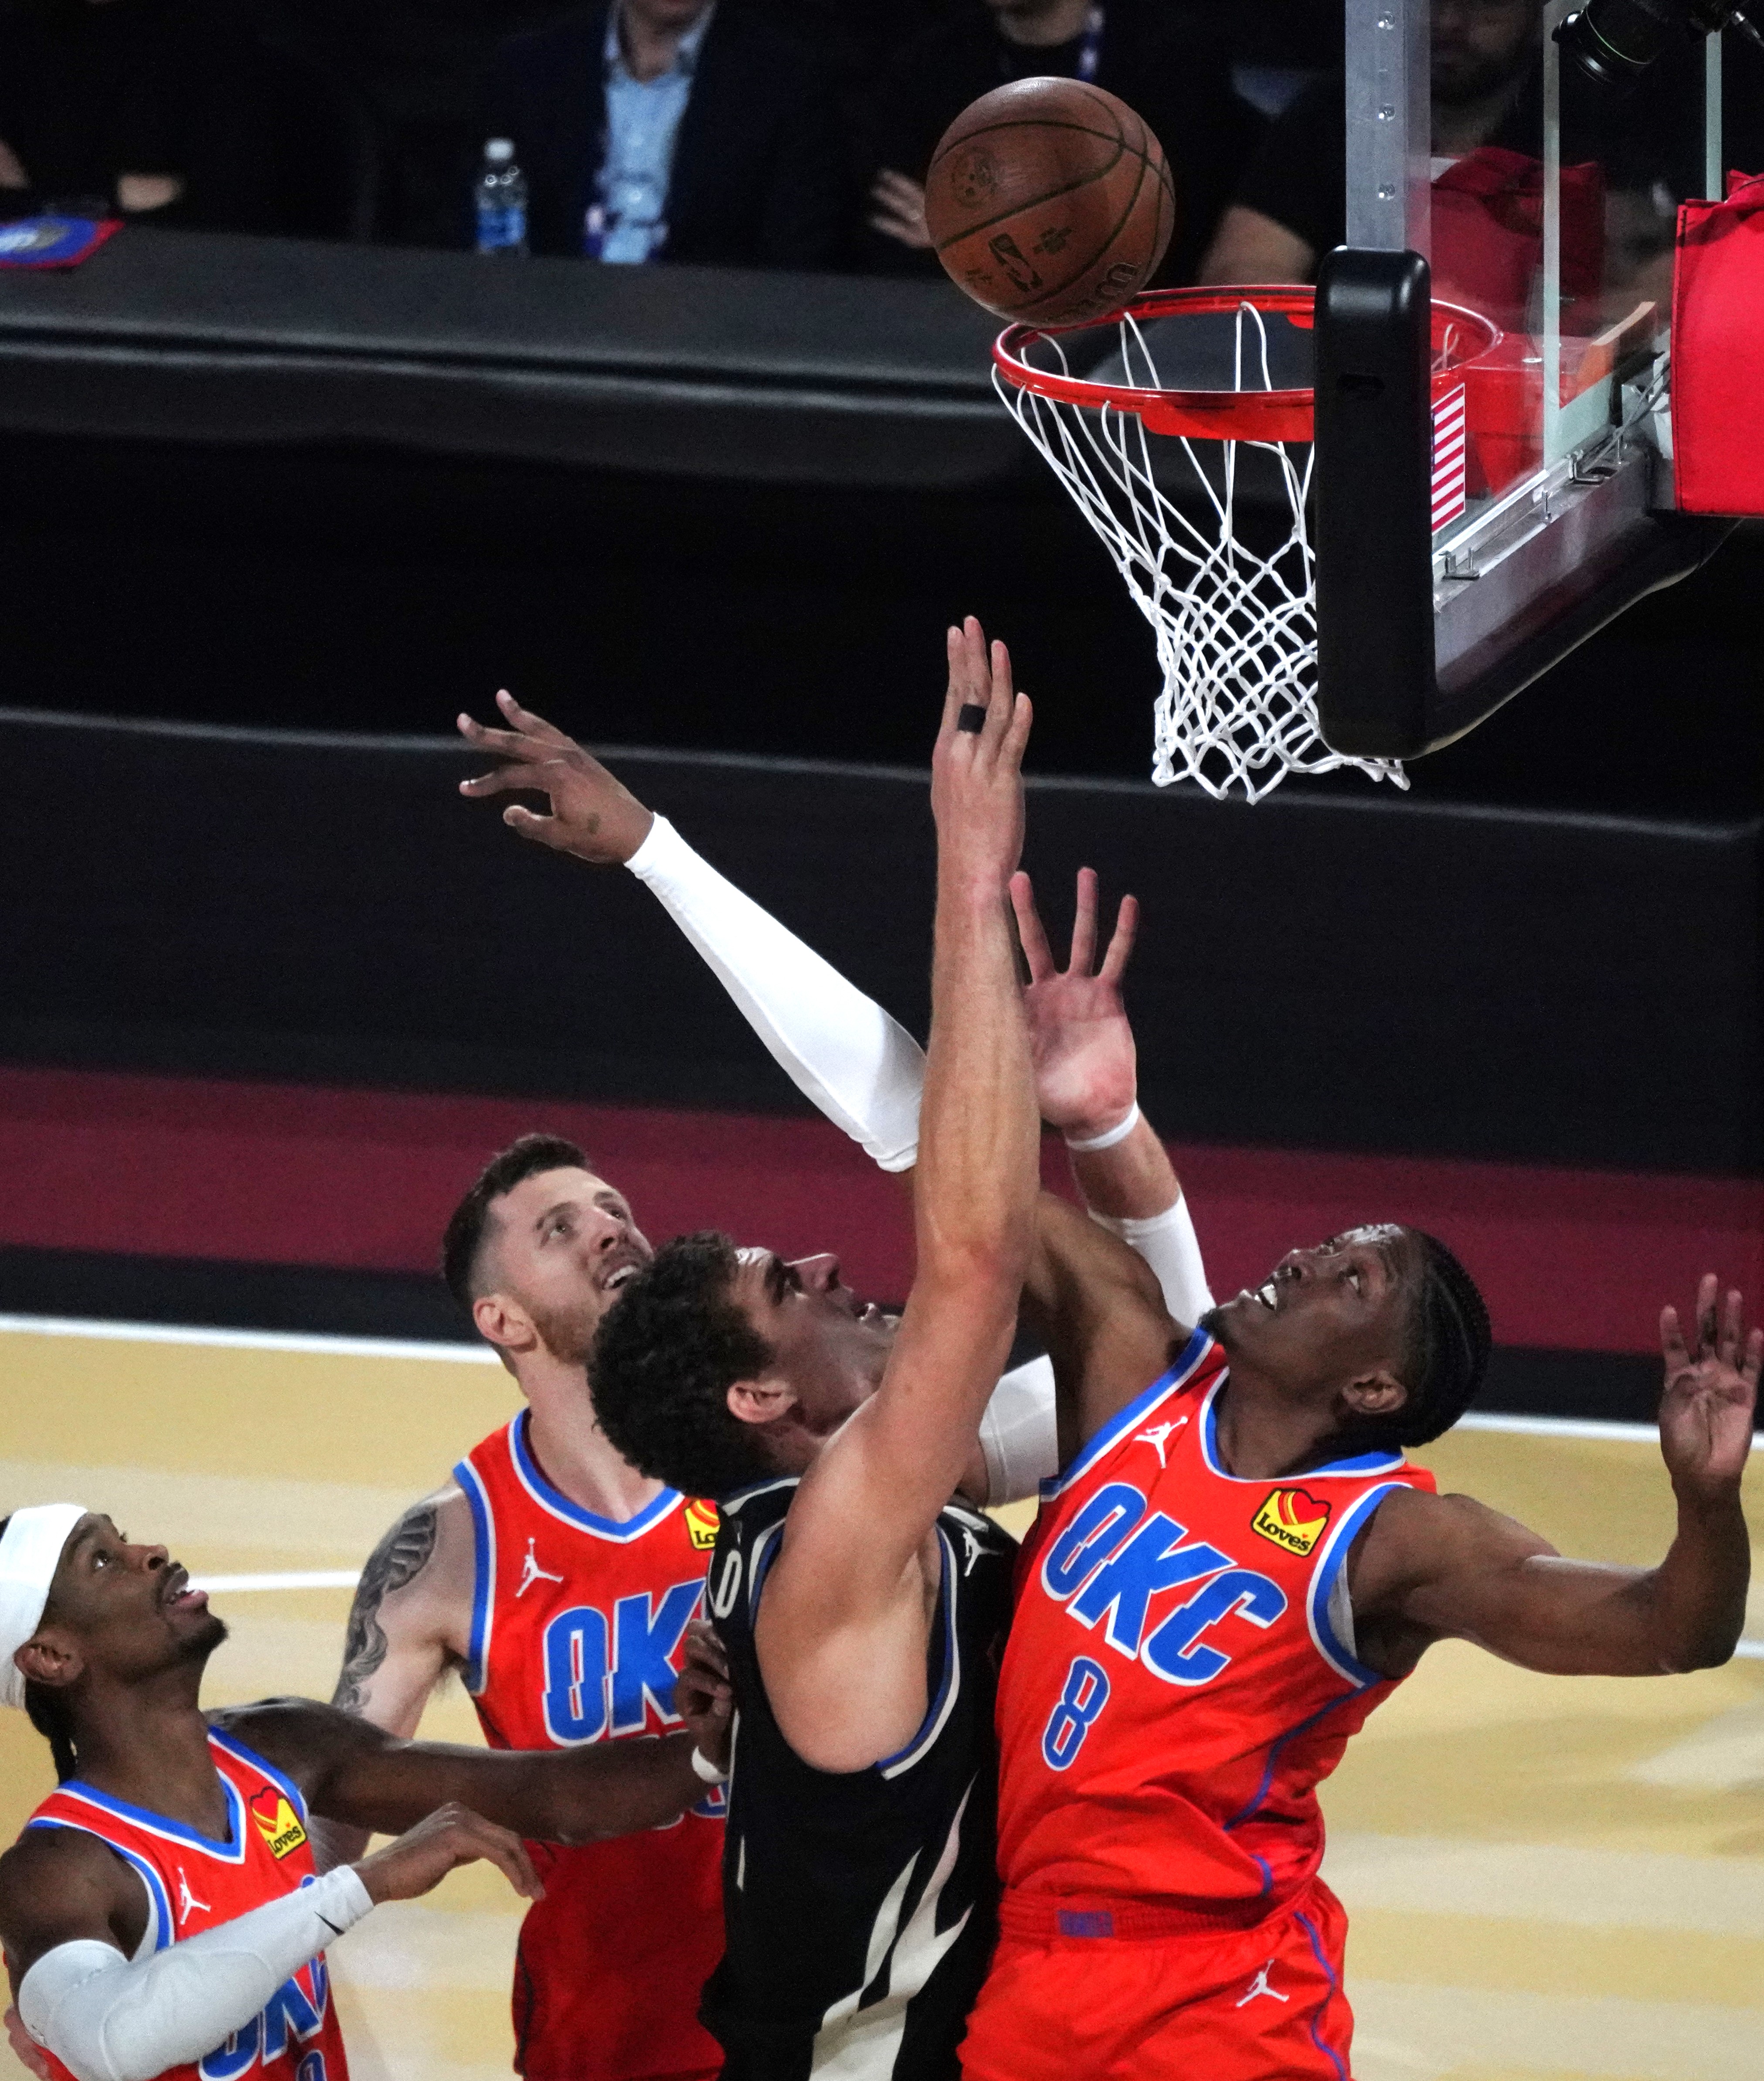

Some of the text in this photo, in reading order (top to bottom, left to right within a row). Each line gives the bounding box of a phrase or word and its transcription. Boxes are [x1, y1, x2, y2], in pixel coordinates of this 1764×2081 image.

[542, 1577, 710, 1745] OK
[1040, 1482, 1288, 1686] OKC
[1042, 1655, 1111, 1771] 8
